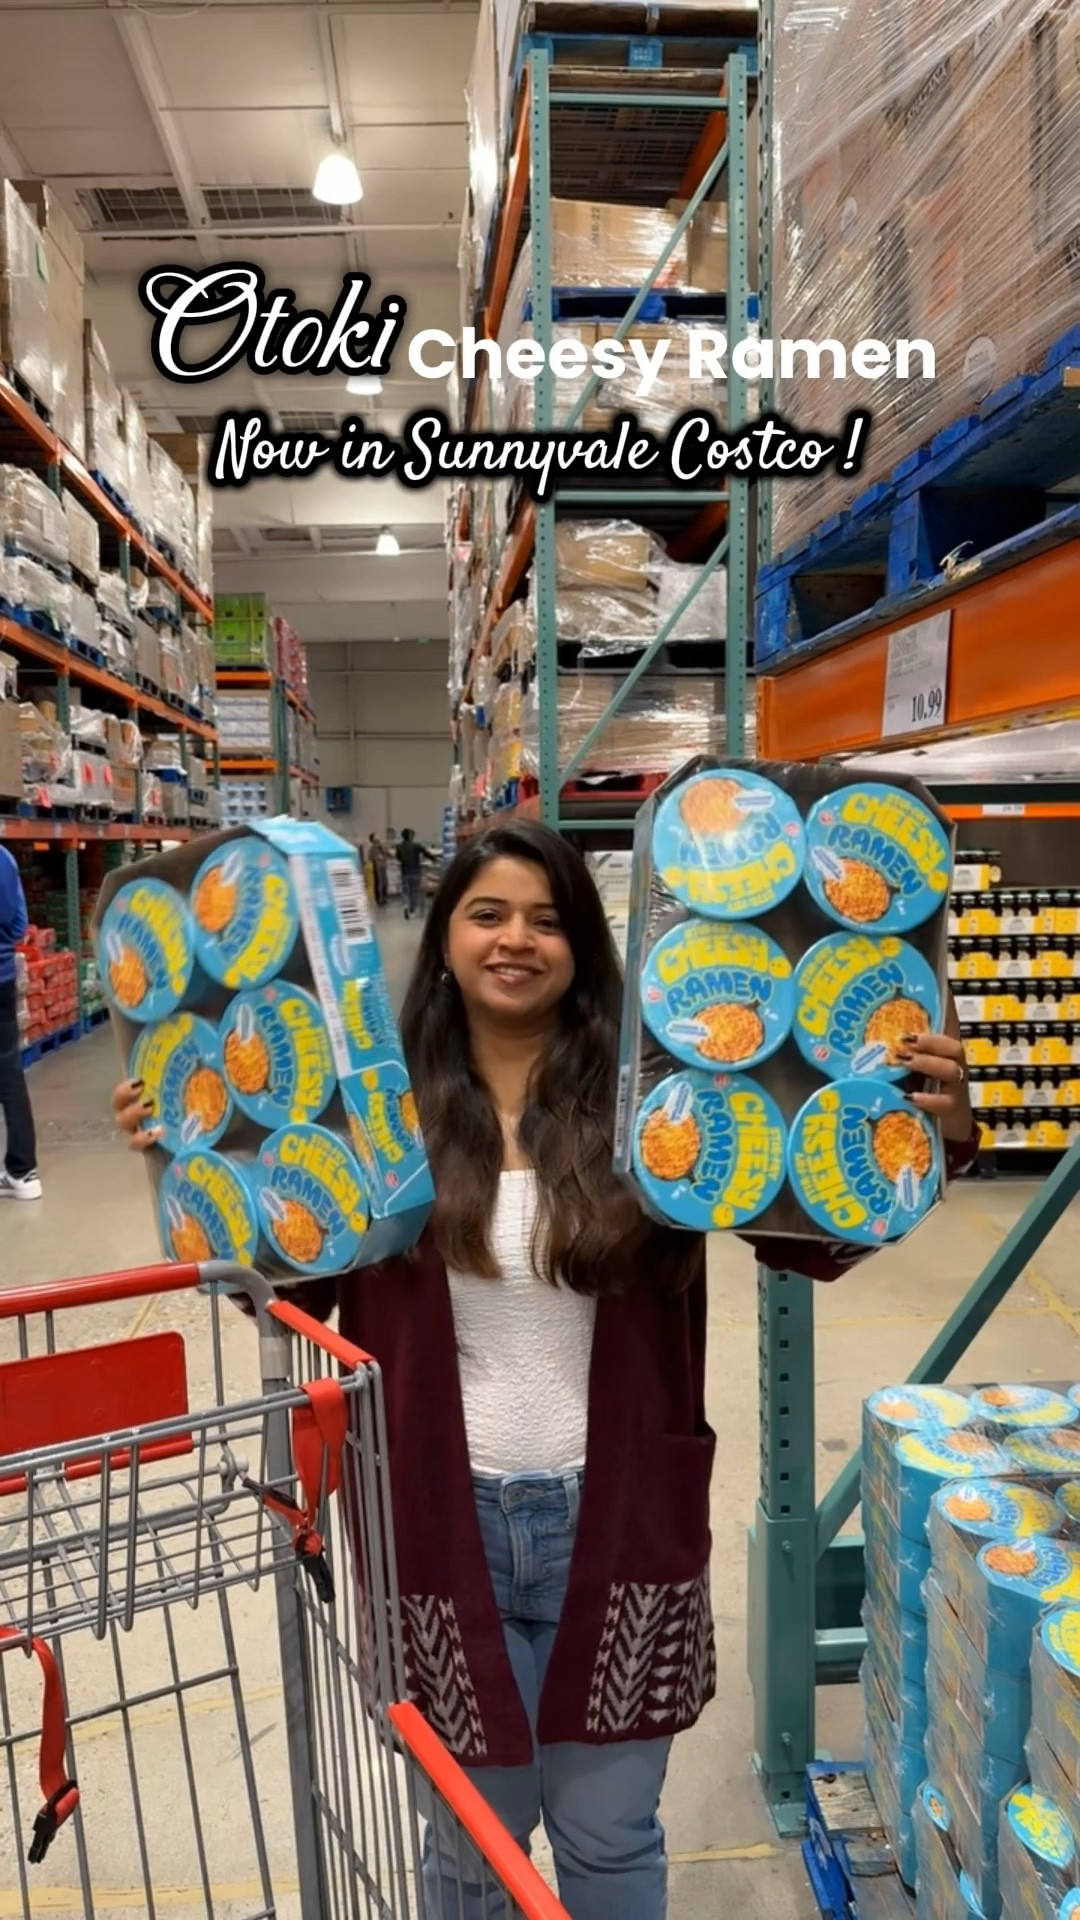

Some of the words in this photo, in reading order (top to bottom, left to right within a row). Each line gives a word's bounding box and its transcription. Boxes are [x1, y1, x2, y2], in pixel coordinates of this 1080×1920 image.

[911, 688, 942, 722] 10.99
[828, 824, 923, 895] RAMEN
[841, 793, 946, 873] CHEESY
[657, 933, 769, 984] CHEESY
[667, 970, 772, 1016] RAMEN
[798, 936, 883, 1036] CHEESY
[255, 1004, 294, 1107] RAMEN
[279, 998, 323, 1107] CHEESY
[828, 960, 905, 1056] RAMEN
[279, 1134, 360, 1214] CHEESY
[691, 1090, 734, 1203] RAMEN
[723, 1092, 770, 1210] CHEESY
[803, 1113, 867, 1228] CHEESY
[842, 1106, 892, 1214] RAMEN
[270, 1164, 346, 1237] RAMEN
